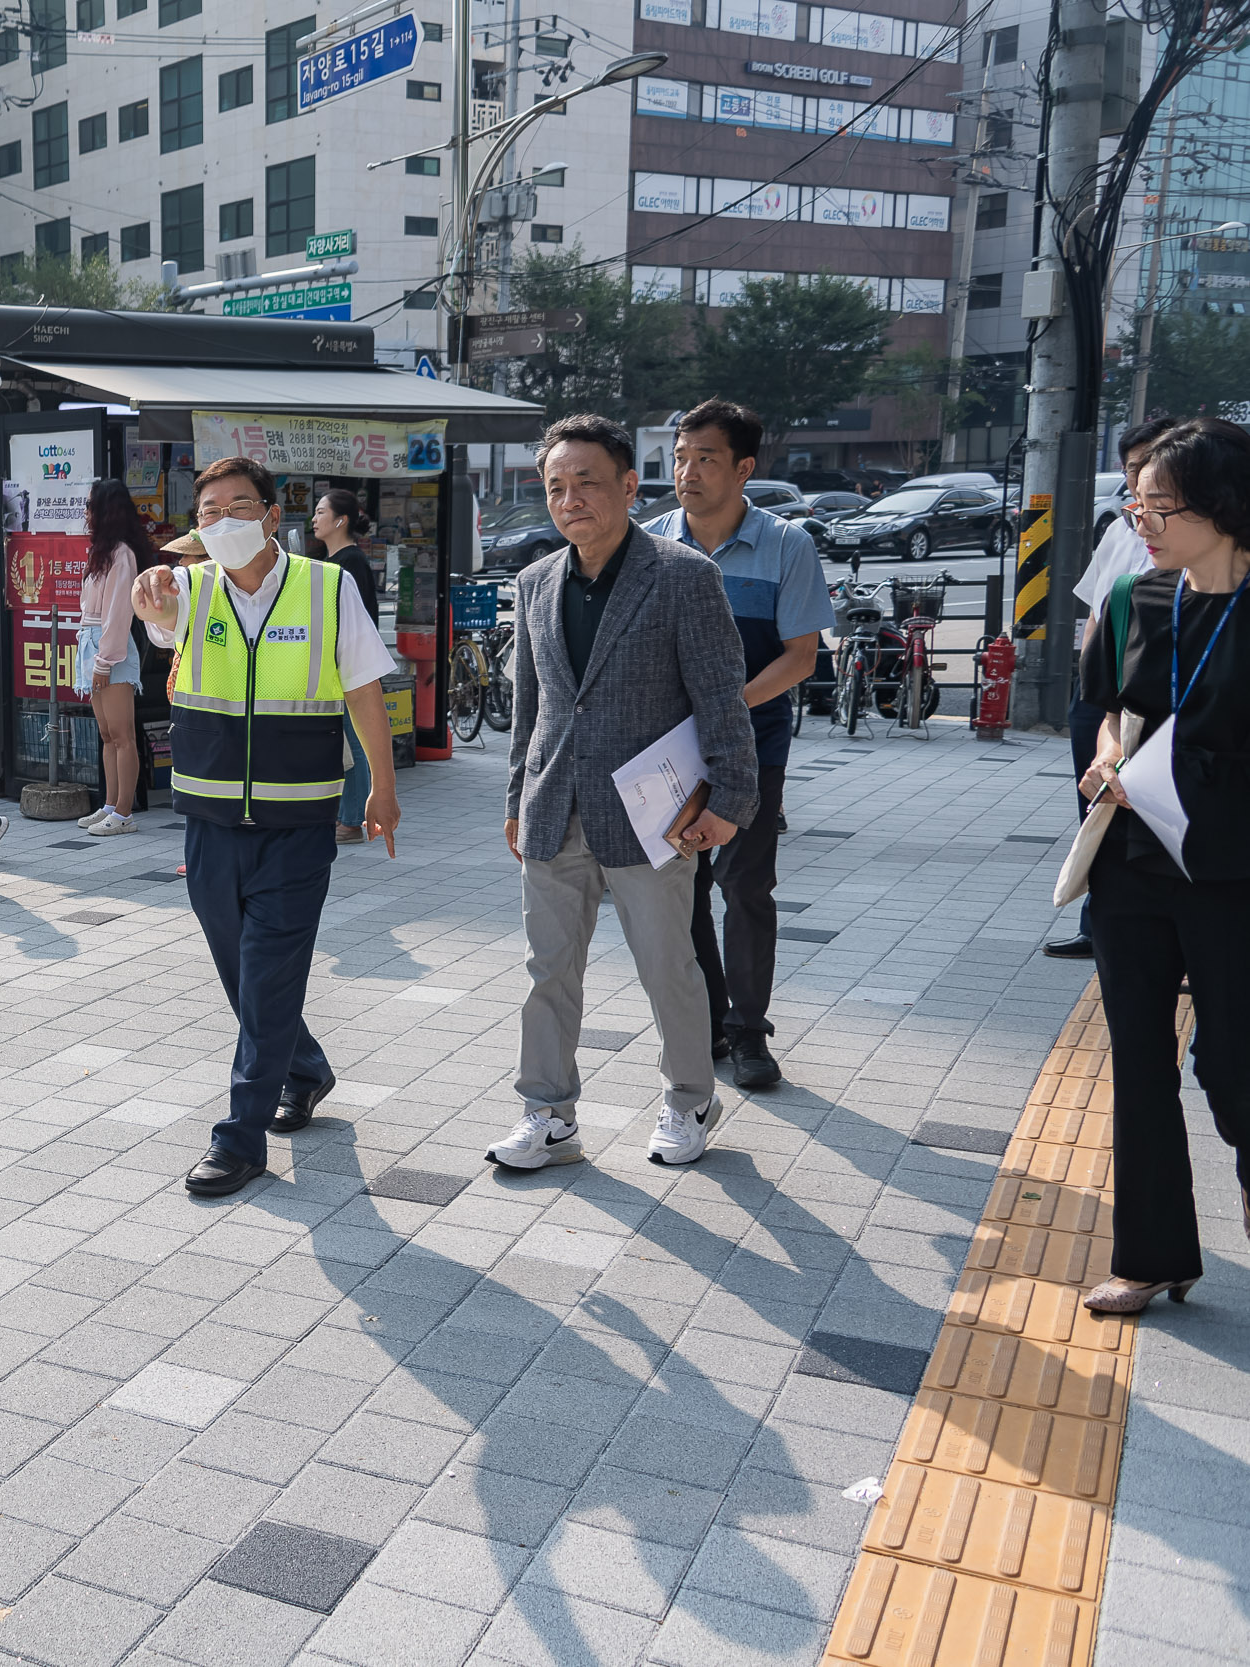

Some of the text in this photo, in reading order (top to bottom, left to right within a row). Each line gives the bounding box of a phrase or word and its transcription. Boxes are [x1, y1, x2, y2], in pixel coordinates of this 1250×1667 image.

[302, 29, 385, 85] 자양로15길
[774, 63, 818, 82] SCREEN
[819, 69, 849, 85] GOLF
[302, 68, 364, 105] Jayang-ro 15-gil
[638, 196, 660, 208] GLEC
[308, 234, 349, 256] 자양사거리
[272, 293, 304, 311] 잠실대교
[306, 287, 340, 305] 건대입구역
[33, 325, 70, 335] HAECHI
[33, 335, 53, 343] SHOP
[38, 445, 63, 457] Lotto
[353, 434, 389, 473] 2등
[410, 439, 442, 465] 26
[48, 559, 62, 576] 1등
